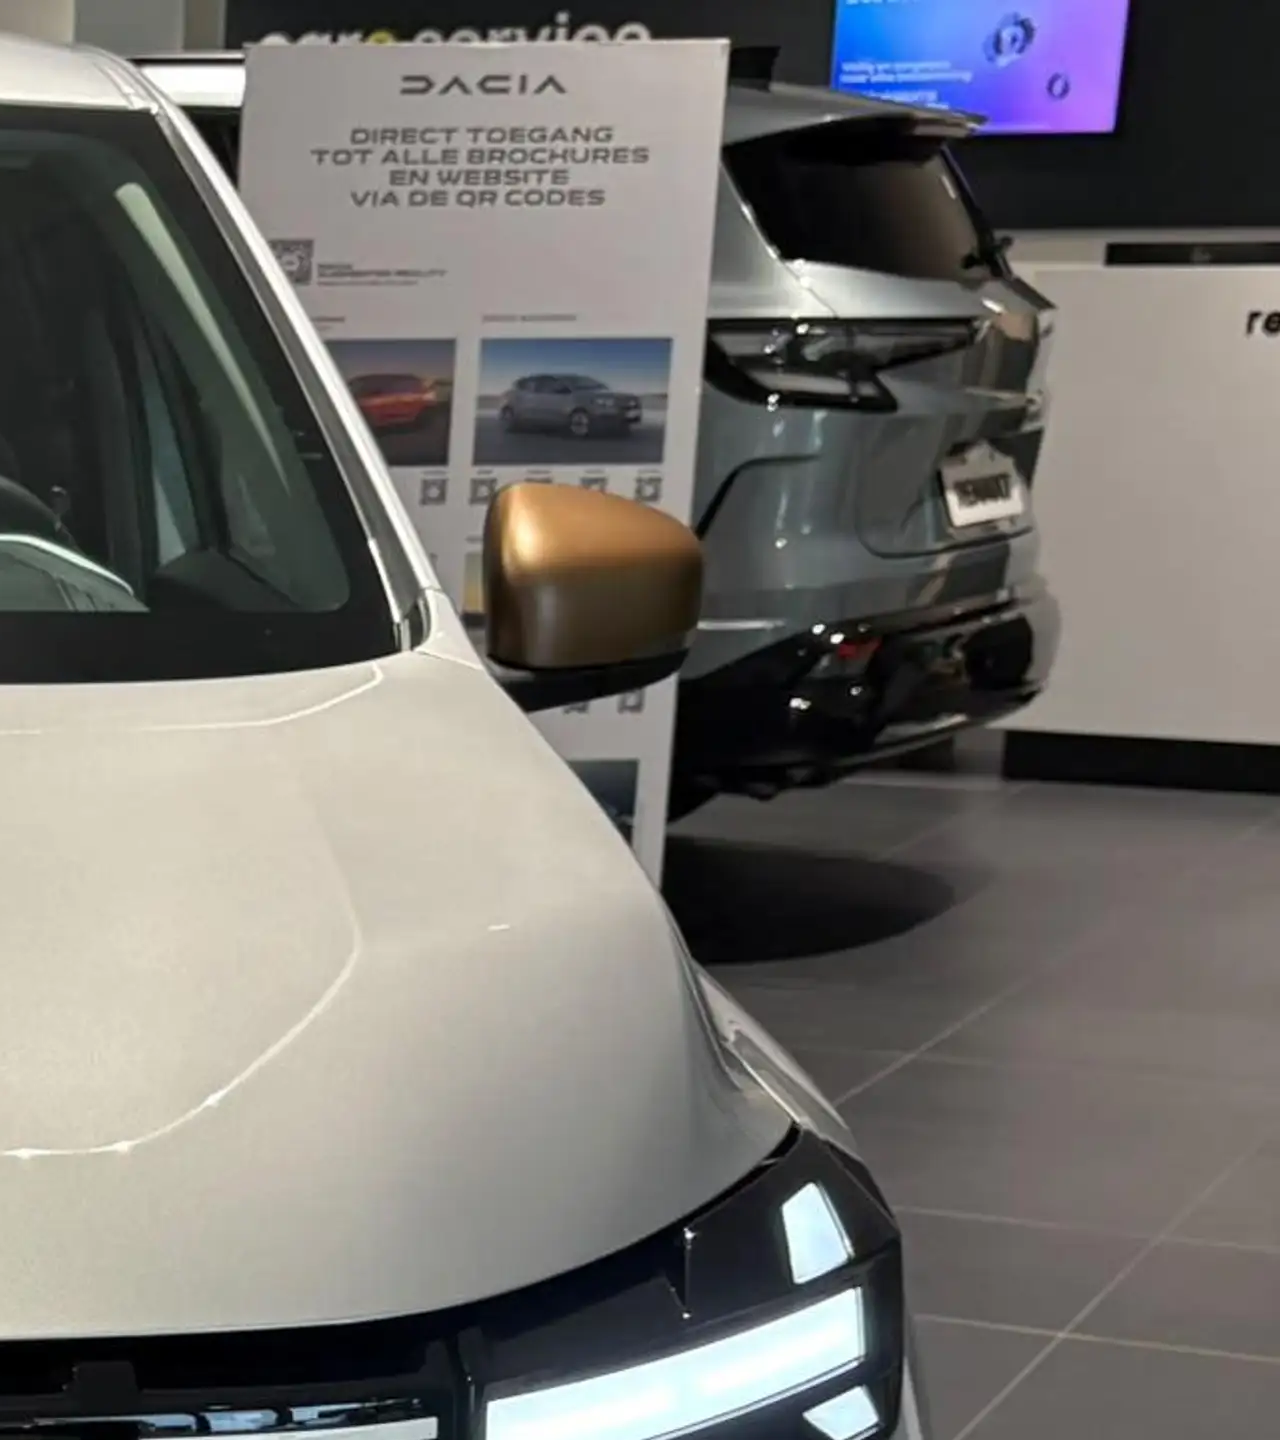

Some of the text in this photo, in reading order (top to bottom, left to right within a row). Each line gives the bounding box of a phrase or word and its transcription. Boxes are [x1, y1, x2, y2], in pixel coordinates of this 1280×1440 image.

[400, 74, 567, 95] DACIA
[350, 126, 614, 145] DIRECT TOEGANG
[310, 147, 649, 166] TOT ALLE BROCHURES
[389, 169, 569, 186] EN WEBSITE
[350, 189, 606, 209] VIA DE QR CODES
